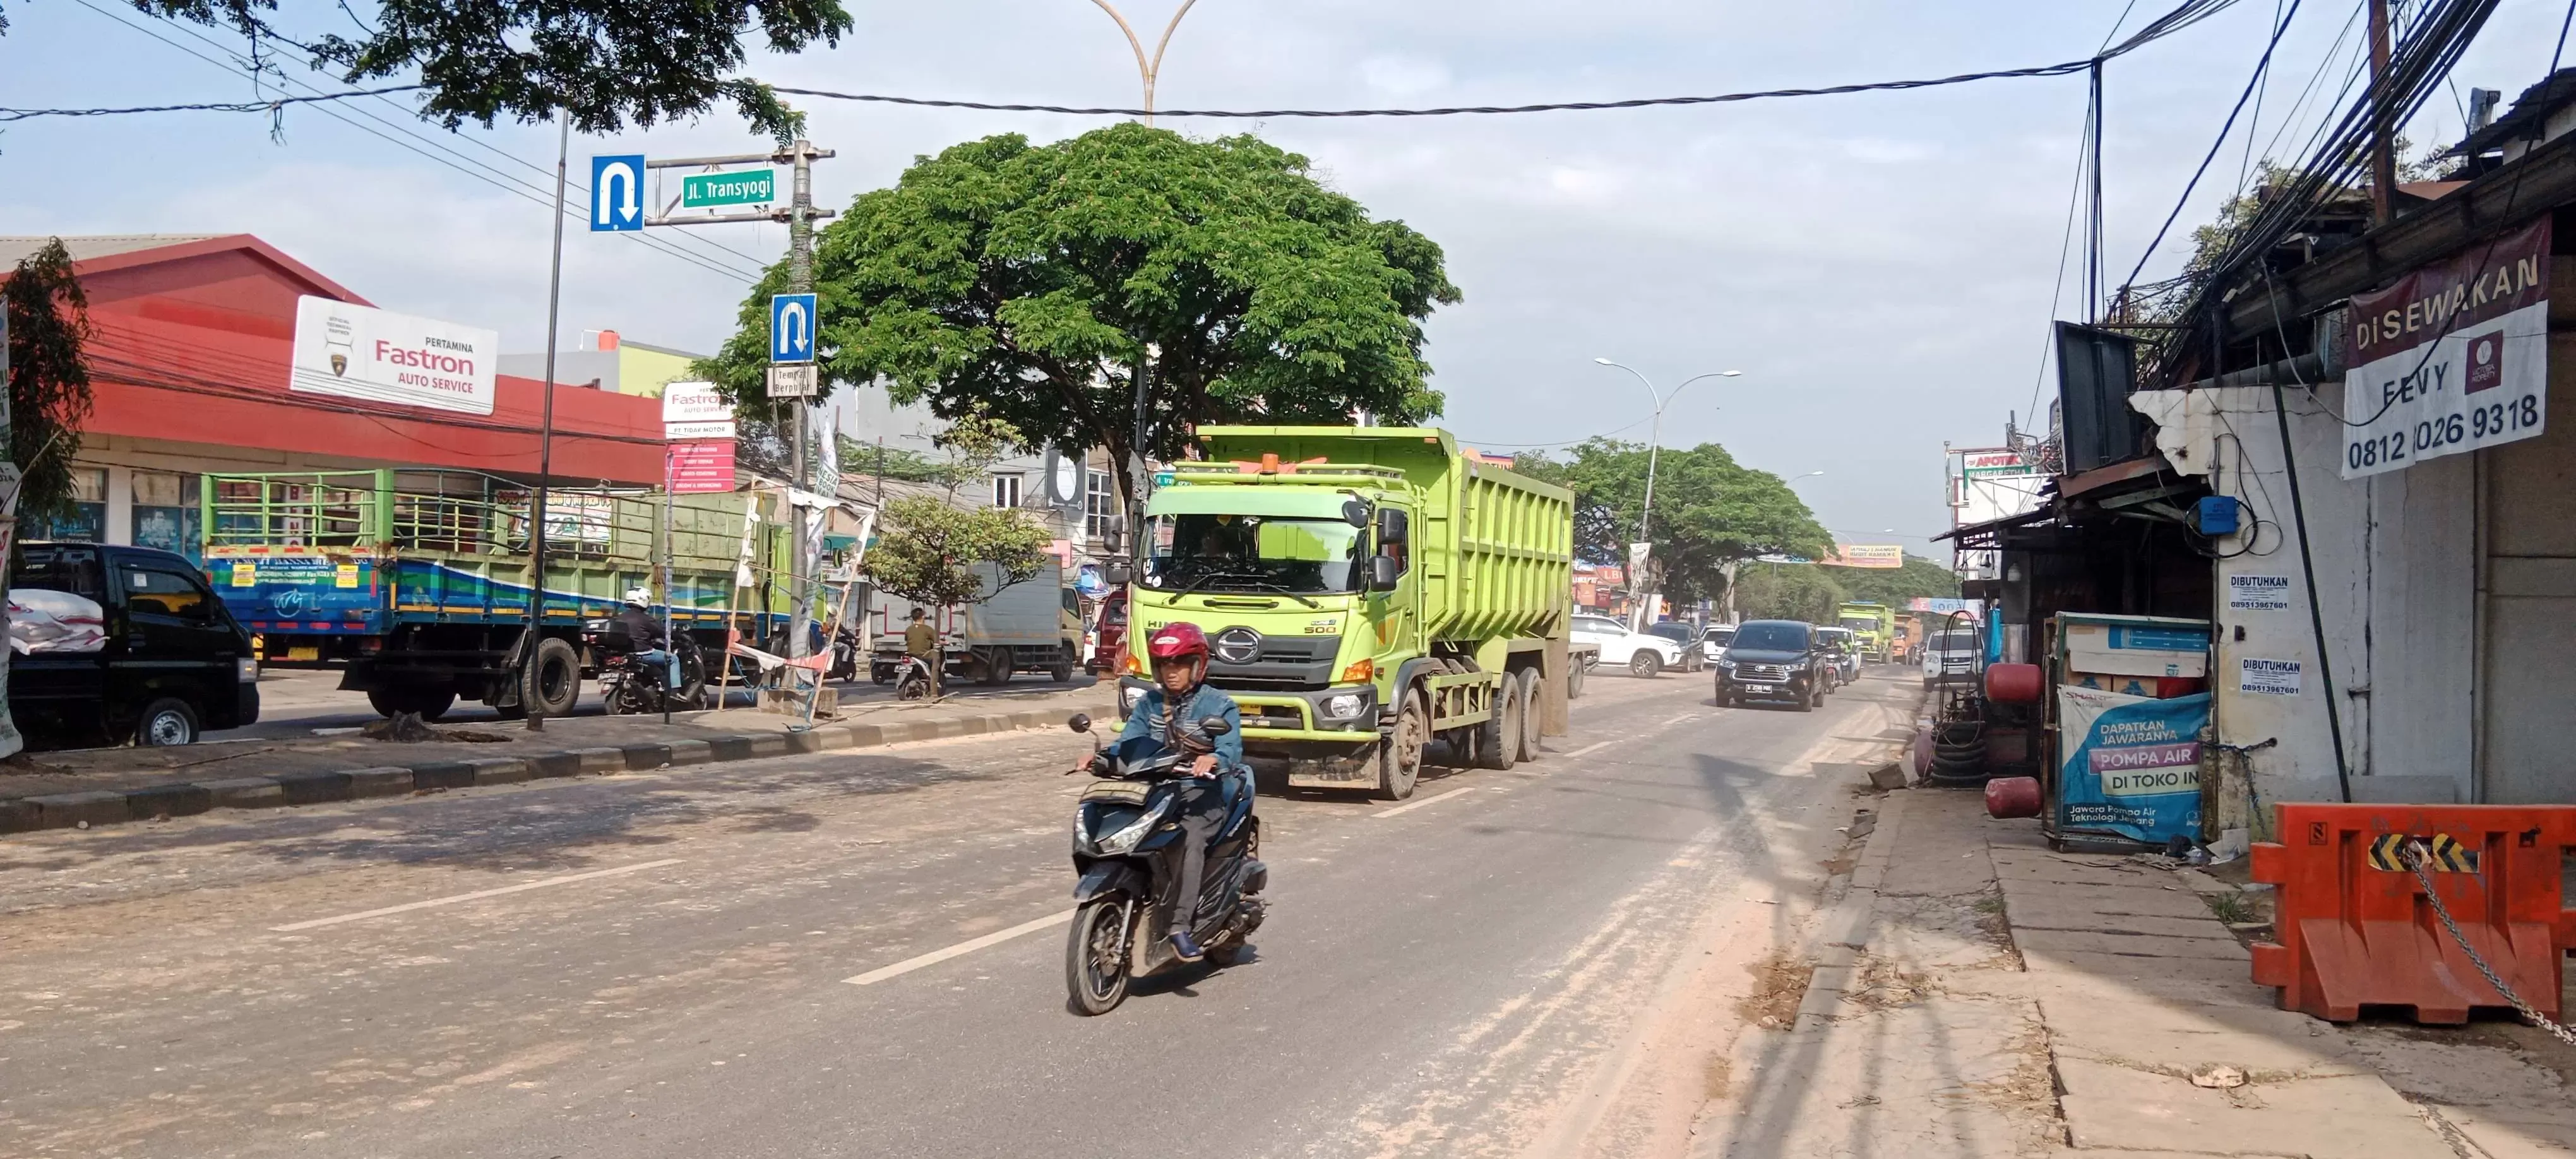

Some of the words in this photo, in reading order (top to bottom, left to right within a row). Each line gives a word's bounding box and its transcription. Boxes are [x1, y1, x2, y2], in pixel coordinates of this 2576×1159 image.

[688, 182, 702, 200] Jl.
[707, 175, 770, 200] Transyogi
[2356, 254, 2538, 351] DISEWAKAN
[426, 336, 474, 354] PERTAMINA
[376, 339, 474, 376] Fastron
[398, 372, 429, 387] AUTO
[432, 377, 473, 394] SERVICE
[2383, 362, 2448, 408] FEVY
[2349, 432, 2406, 469] 0812
[2472, 394, 2538, 439] 9318
[1969, 470, 2026, 478] MARGARETHA
[2231, 576, 2288, 587] DIBUTUHKAN
[2231, 601, 2287, 609] 089513967601
[2243, 659, 2300, 672] DIBUTUHKAN
[2242, 684, 2299, 694] 089513967601
[2101, 720, 2165, 735] DAPATKAN
[2101, 730, 2178, 746] JAWARANYA
[2101, 752, 2159, 768] POMPA
[2164, 749, 2191, 763] AIR
[2113, 777, 2128, 789] DI
[2132, 773, 2178, 788] TOKO
[2070, 805, 2106, 814] Jawara
[2108, 805, 2140, 816] Pompa
[2070, 814, 2116, 823] Teknologi
[2119, 815, 2155, 826] Jepang
